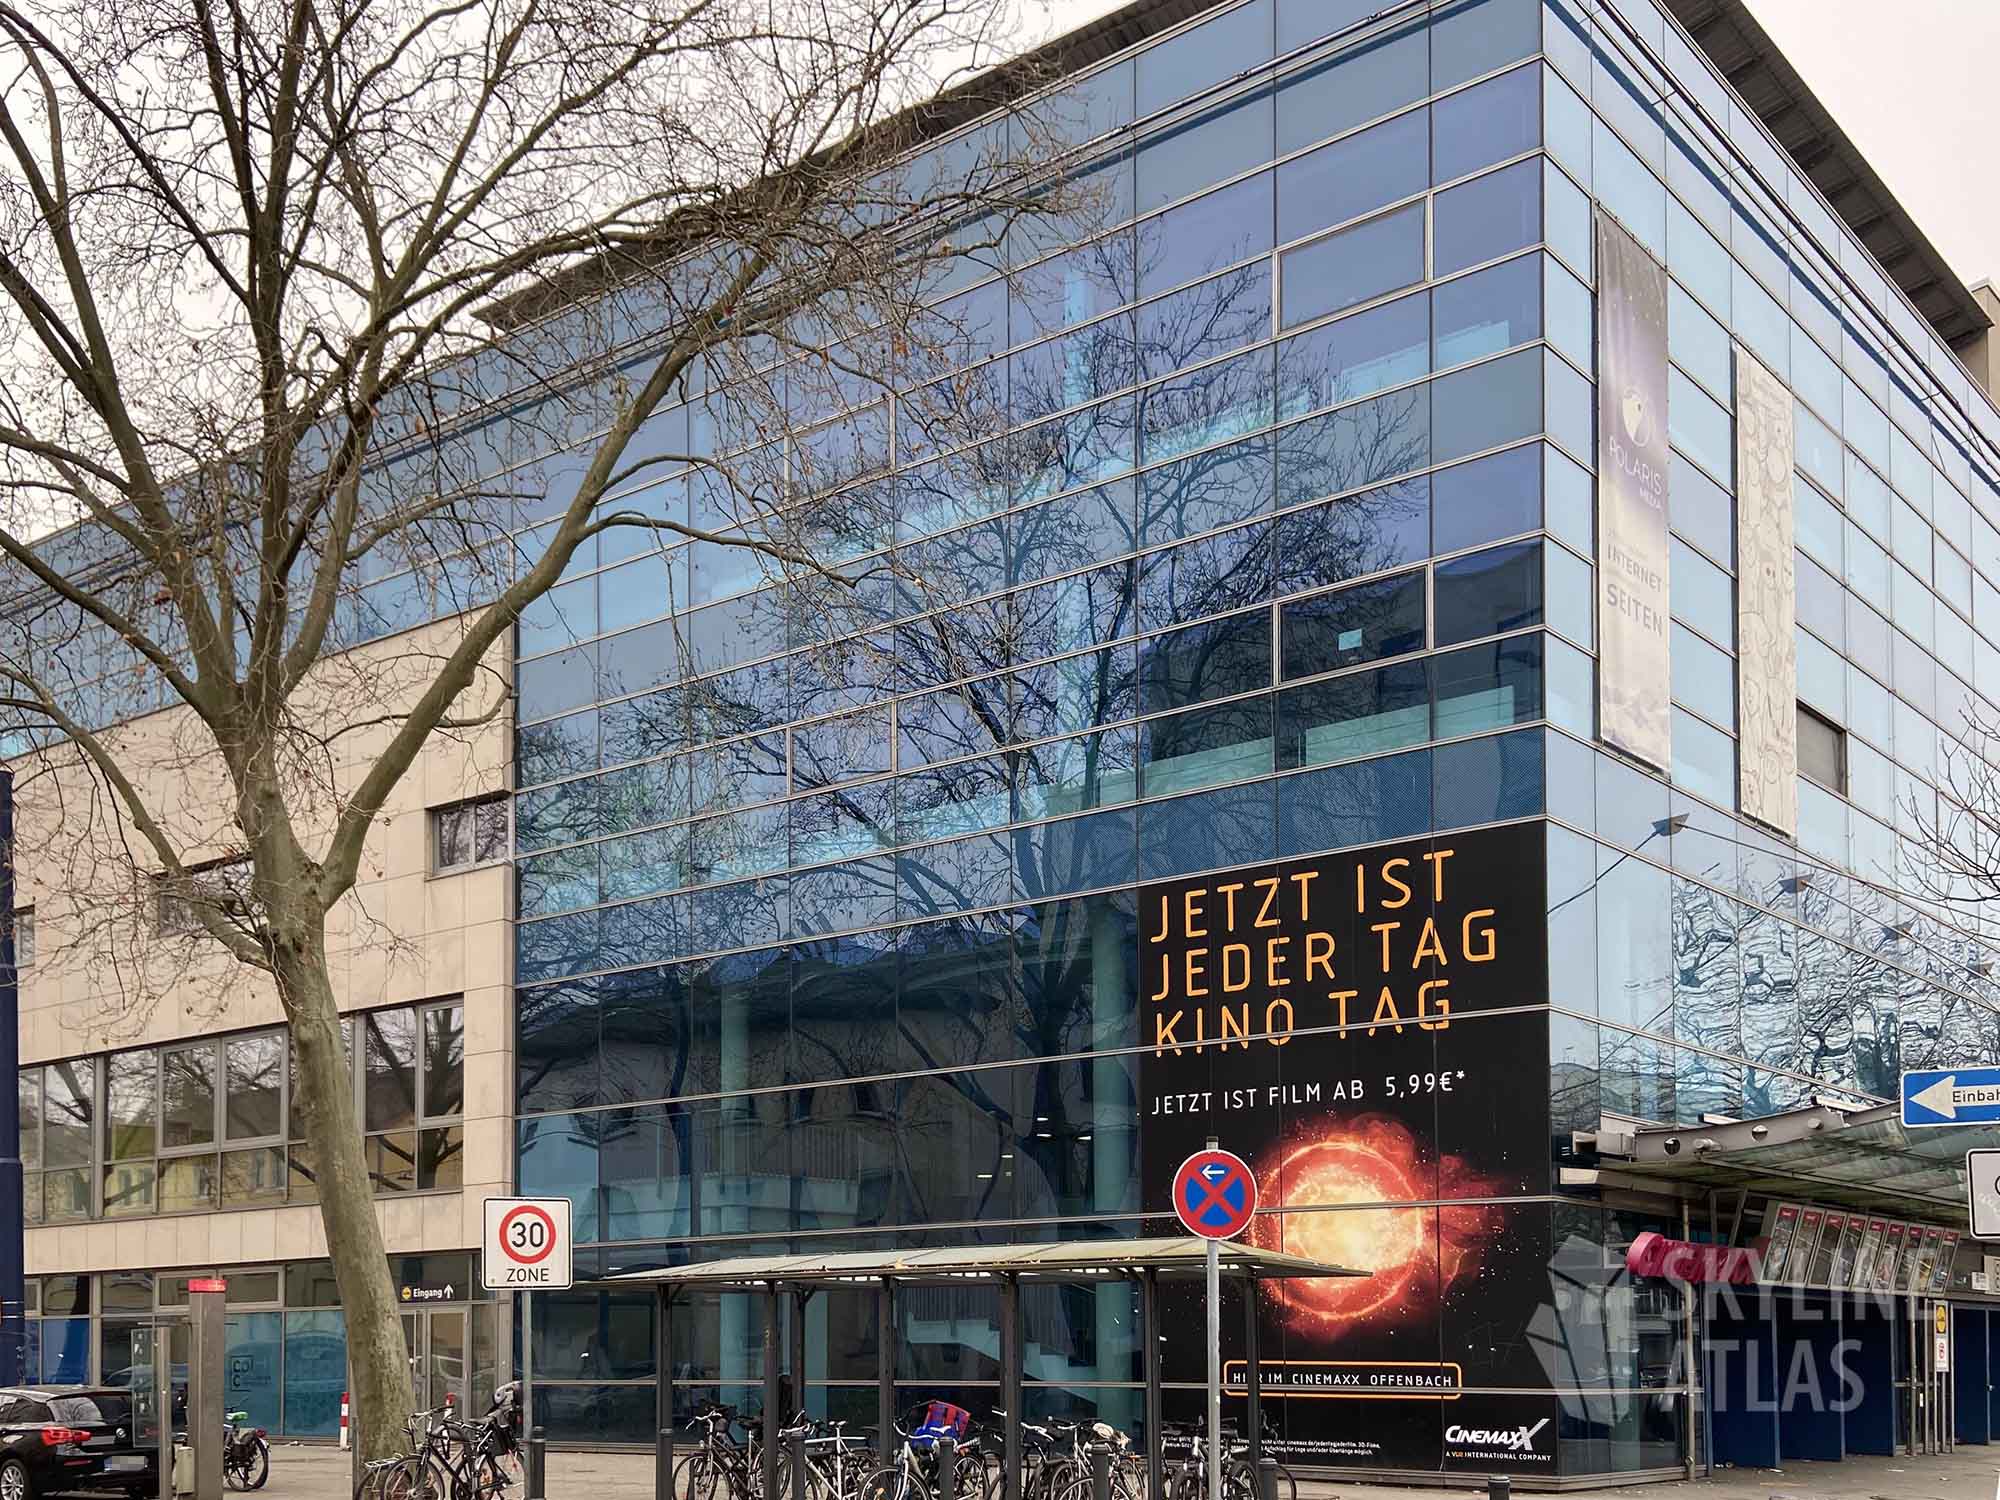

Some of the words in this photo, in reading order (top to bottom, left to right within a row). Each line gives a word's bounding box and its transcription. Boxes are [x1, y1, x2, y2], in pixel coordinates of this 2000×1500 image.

[1608, 435, 1664, 496] POLARIS
[1607, 544, 1663, 594] INTERNET
[1606, 583, 1664, 637] SEITEN
[1150, 871, 1320, 943] JETZT
[1357, 849, 1455, 913] IST
[1151, 932, 1336, 1001] JEDER
[1370, 908, 1496, 974] TAG
[1155, 998, 1295, 1058] KINO
[1327, 979, 1451, 1040] TAG
[1151, 1092, 1214, 1116] JETZT
[1223, 1088, 1258, 1110] IST
[1269, 1082, 1321, 1106] FILM
[1333, 1078, 1364, 1101] AB
[511, 1222, 545, 1249] 30
[413, 1288, 443, 1299] Eingang
[506, 1267, 550, 1283] ZONE
[1232, 1372, 1263, 1384] HIR
[1268, 1373, 1283, 1384] IM
[1291, 1373, 1360, 1385] CINEMAXX
[1370, 1374, 1452, 1387] OFFENBACH
[1464, 1452, 1517, 1460] INTERNATIONAL
